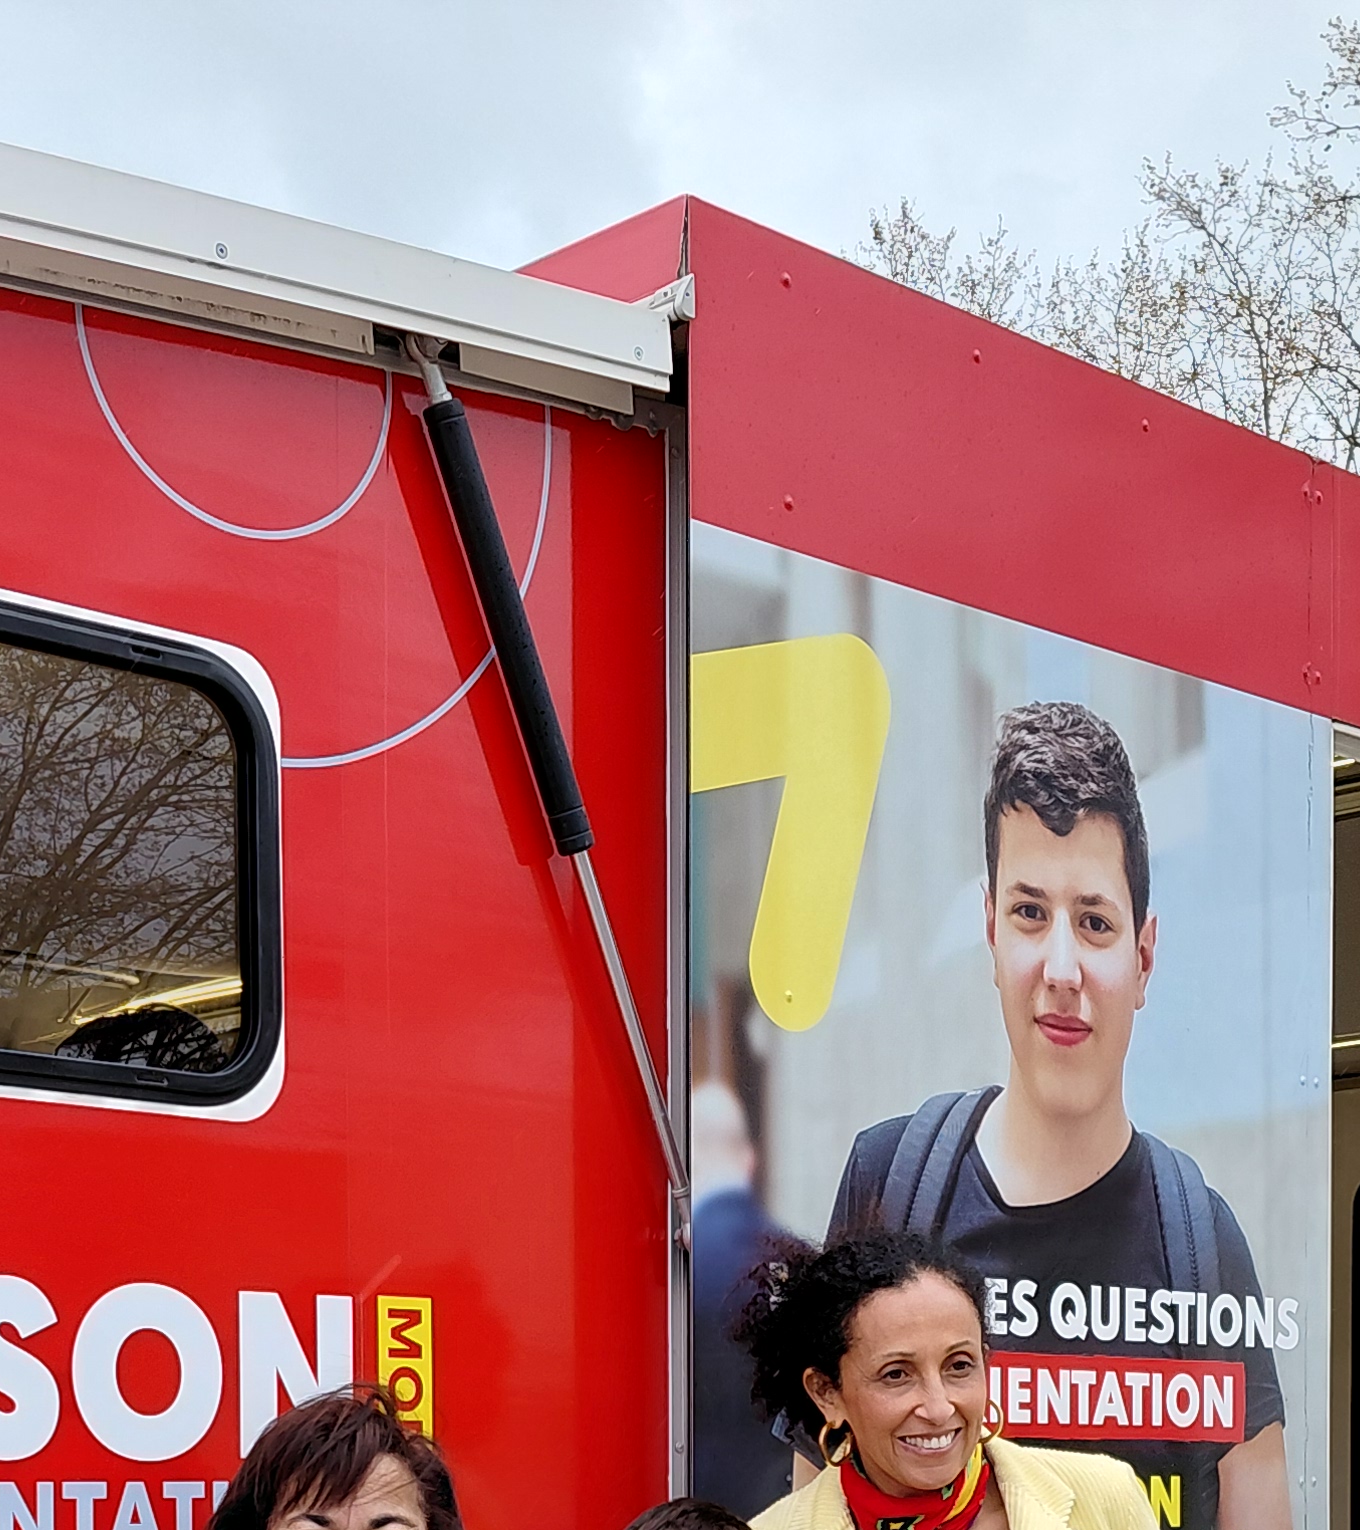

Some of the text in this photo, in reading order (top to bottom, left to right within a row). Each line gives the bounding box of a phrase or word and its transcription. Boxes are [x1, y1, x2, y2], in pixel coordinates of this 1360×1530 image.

[1050, 1282, 1300, 1350] QUESTIONS
[983, 1366, 1234, 1428] IENTATION
[1136, 1475, 1181, 1528] N
